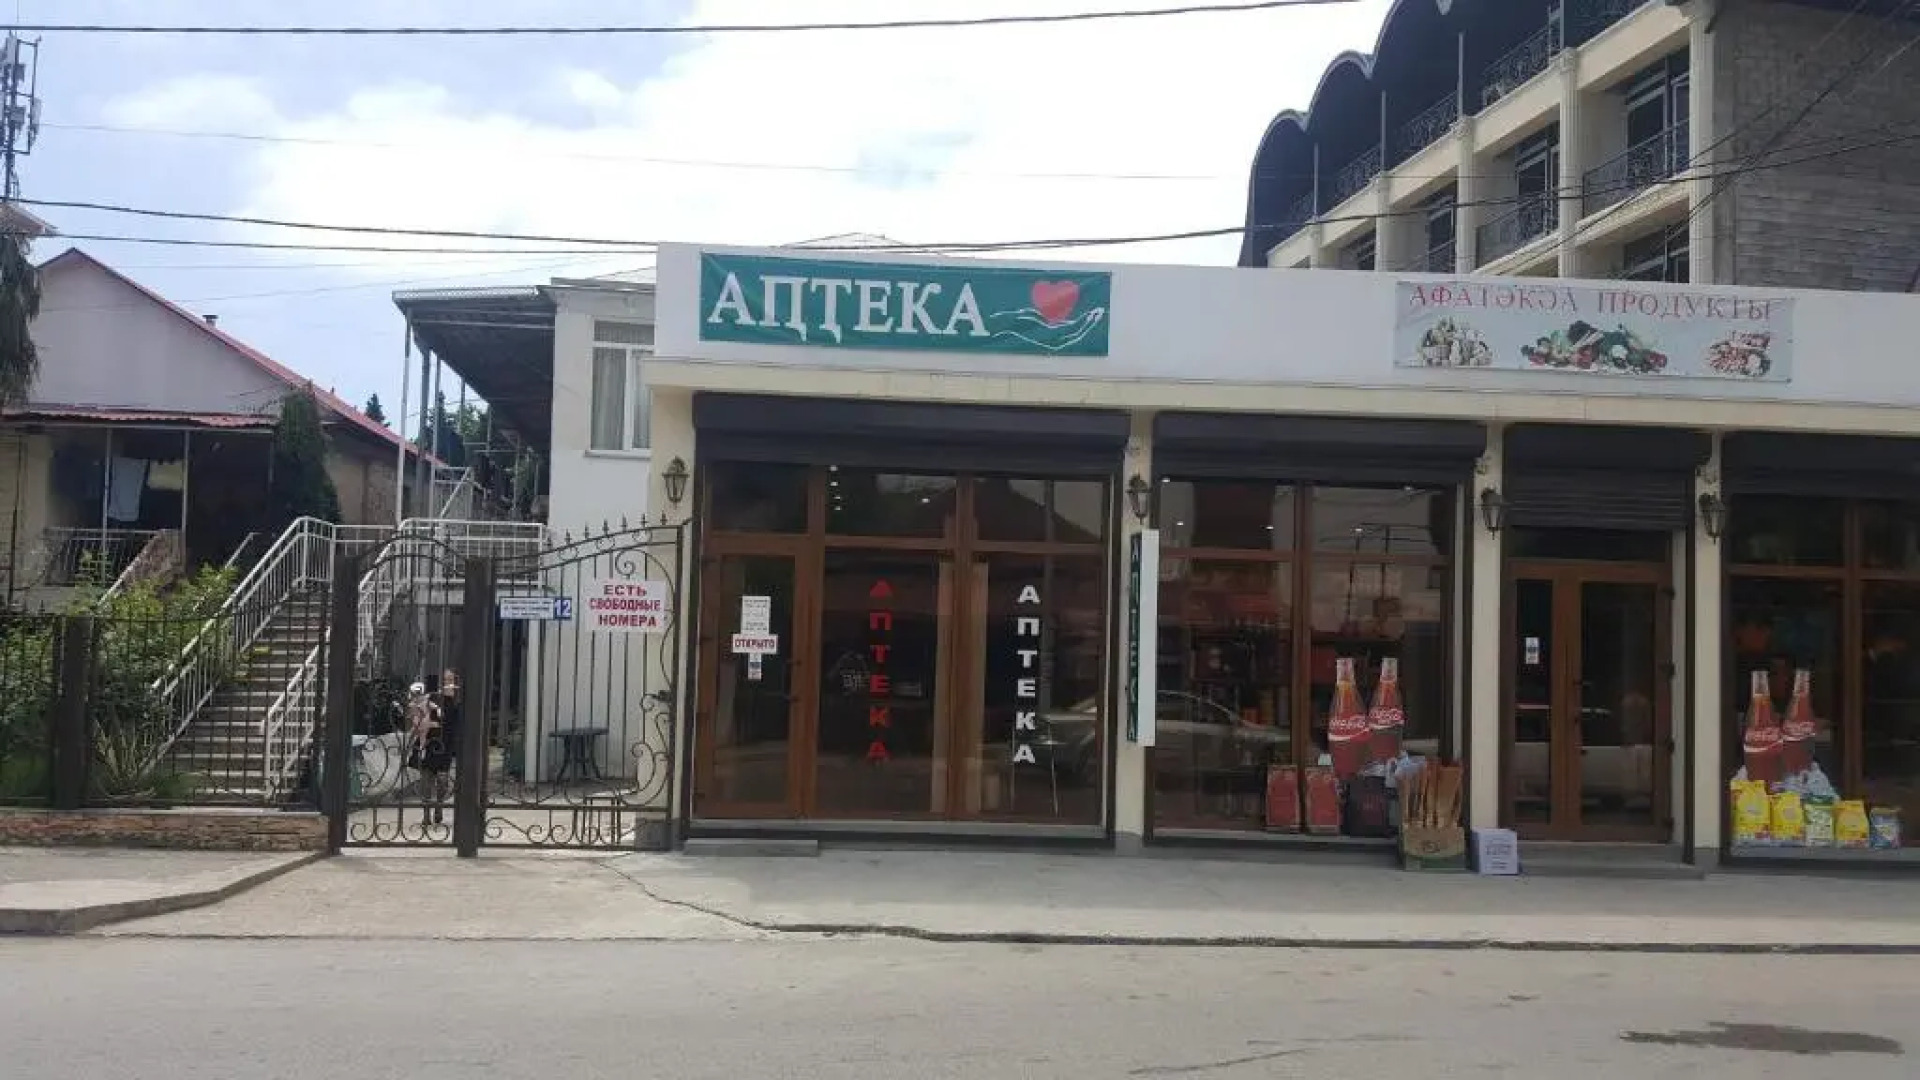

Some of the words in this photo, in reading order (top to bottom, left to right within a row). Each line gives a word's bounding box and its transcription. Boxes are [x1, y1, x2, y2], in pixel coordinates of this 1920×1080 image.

[1598, 291, 1772, 320] ПРОДУКТЫ
[603, 584, 647, 597] ЕСТЬ
[555, 599, 571, 617] 12
[590, 597, 661, 611] СВОБОДНЫЕ
[598, 614, 656, 627] НОМЕРА
[734, 639, 775, 648] ОТКРЫТО
[869, 578, 893, 763] АПТЕКА
[1014, 584, 1041, 764] АПТЕКА
